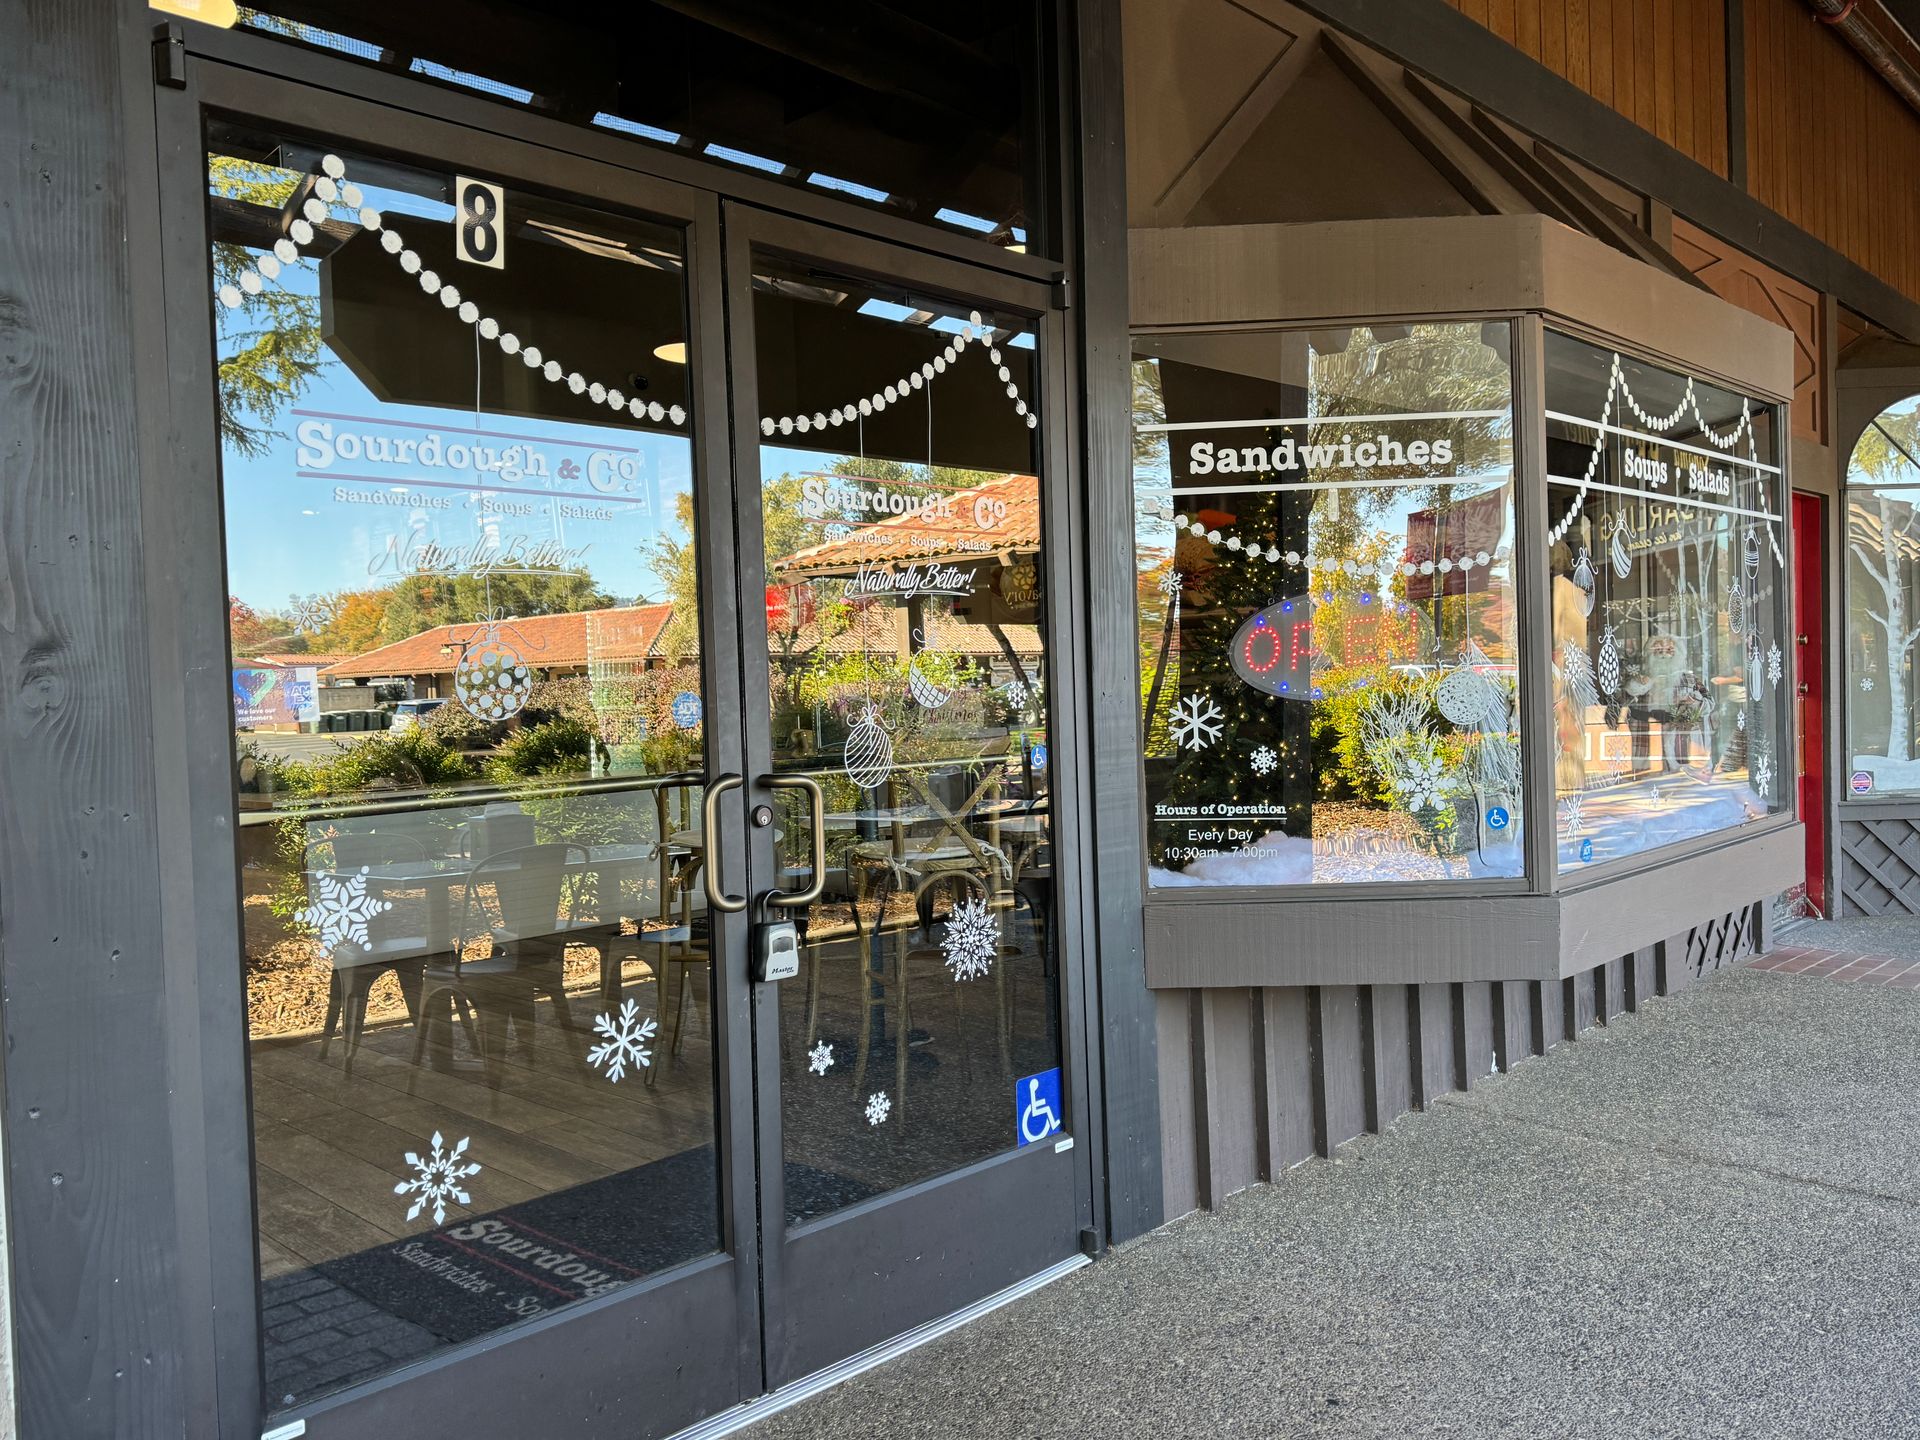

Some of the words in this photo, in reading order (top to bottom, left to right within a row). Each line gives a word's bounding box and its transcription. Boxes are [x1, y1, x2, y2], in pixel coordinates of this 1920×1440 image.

[463, 184, 497, 262] 8
[296, 420, 549, 482] Sourdough
[557, 458, 581, 480] &
[1189, 435, 1453, 475] Sandwiches
[1624, 448, 1668, 488] Soups
[1689, 462, 1730, 496] Salads
[334, 486, 452, 509] Sandwiches
[483, 498, 532, 518] Soups
[560, 503, 613, 521] Salads
[802, 479, 950, 523] Sourdough
[368, 529, 500, 580] Naturally
[824, 529, 893, 545] Sandwiches
[910, 535, 943, 549] Soups
[957, 538, 991, 551] Salads
[844, 560, 922, 599] Naturally
[919, 562, 977, 590] Better!
[1245, 607, 1420, 675] OPEN
[1155, 804, 1198, 816] Hours
[1200, 804, 1216, 815] of
[1217, 803, 1287, 817] Operation
[1164, 846, 1219, 859] 10:30am
[1231, 845, 1278, 860] 7:00pm
[1188, 829, 1224, 843] Every
[1228, 828, 1254, 843] Day
[392, 1242, 497, 1293] Sandwiches
